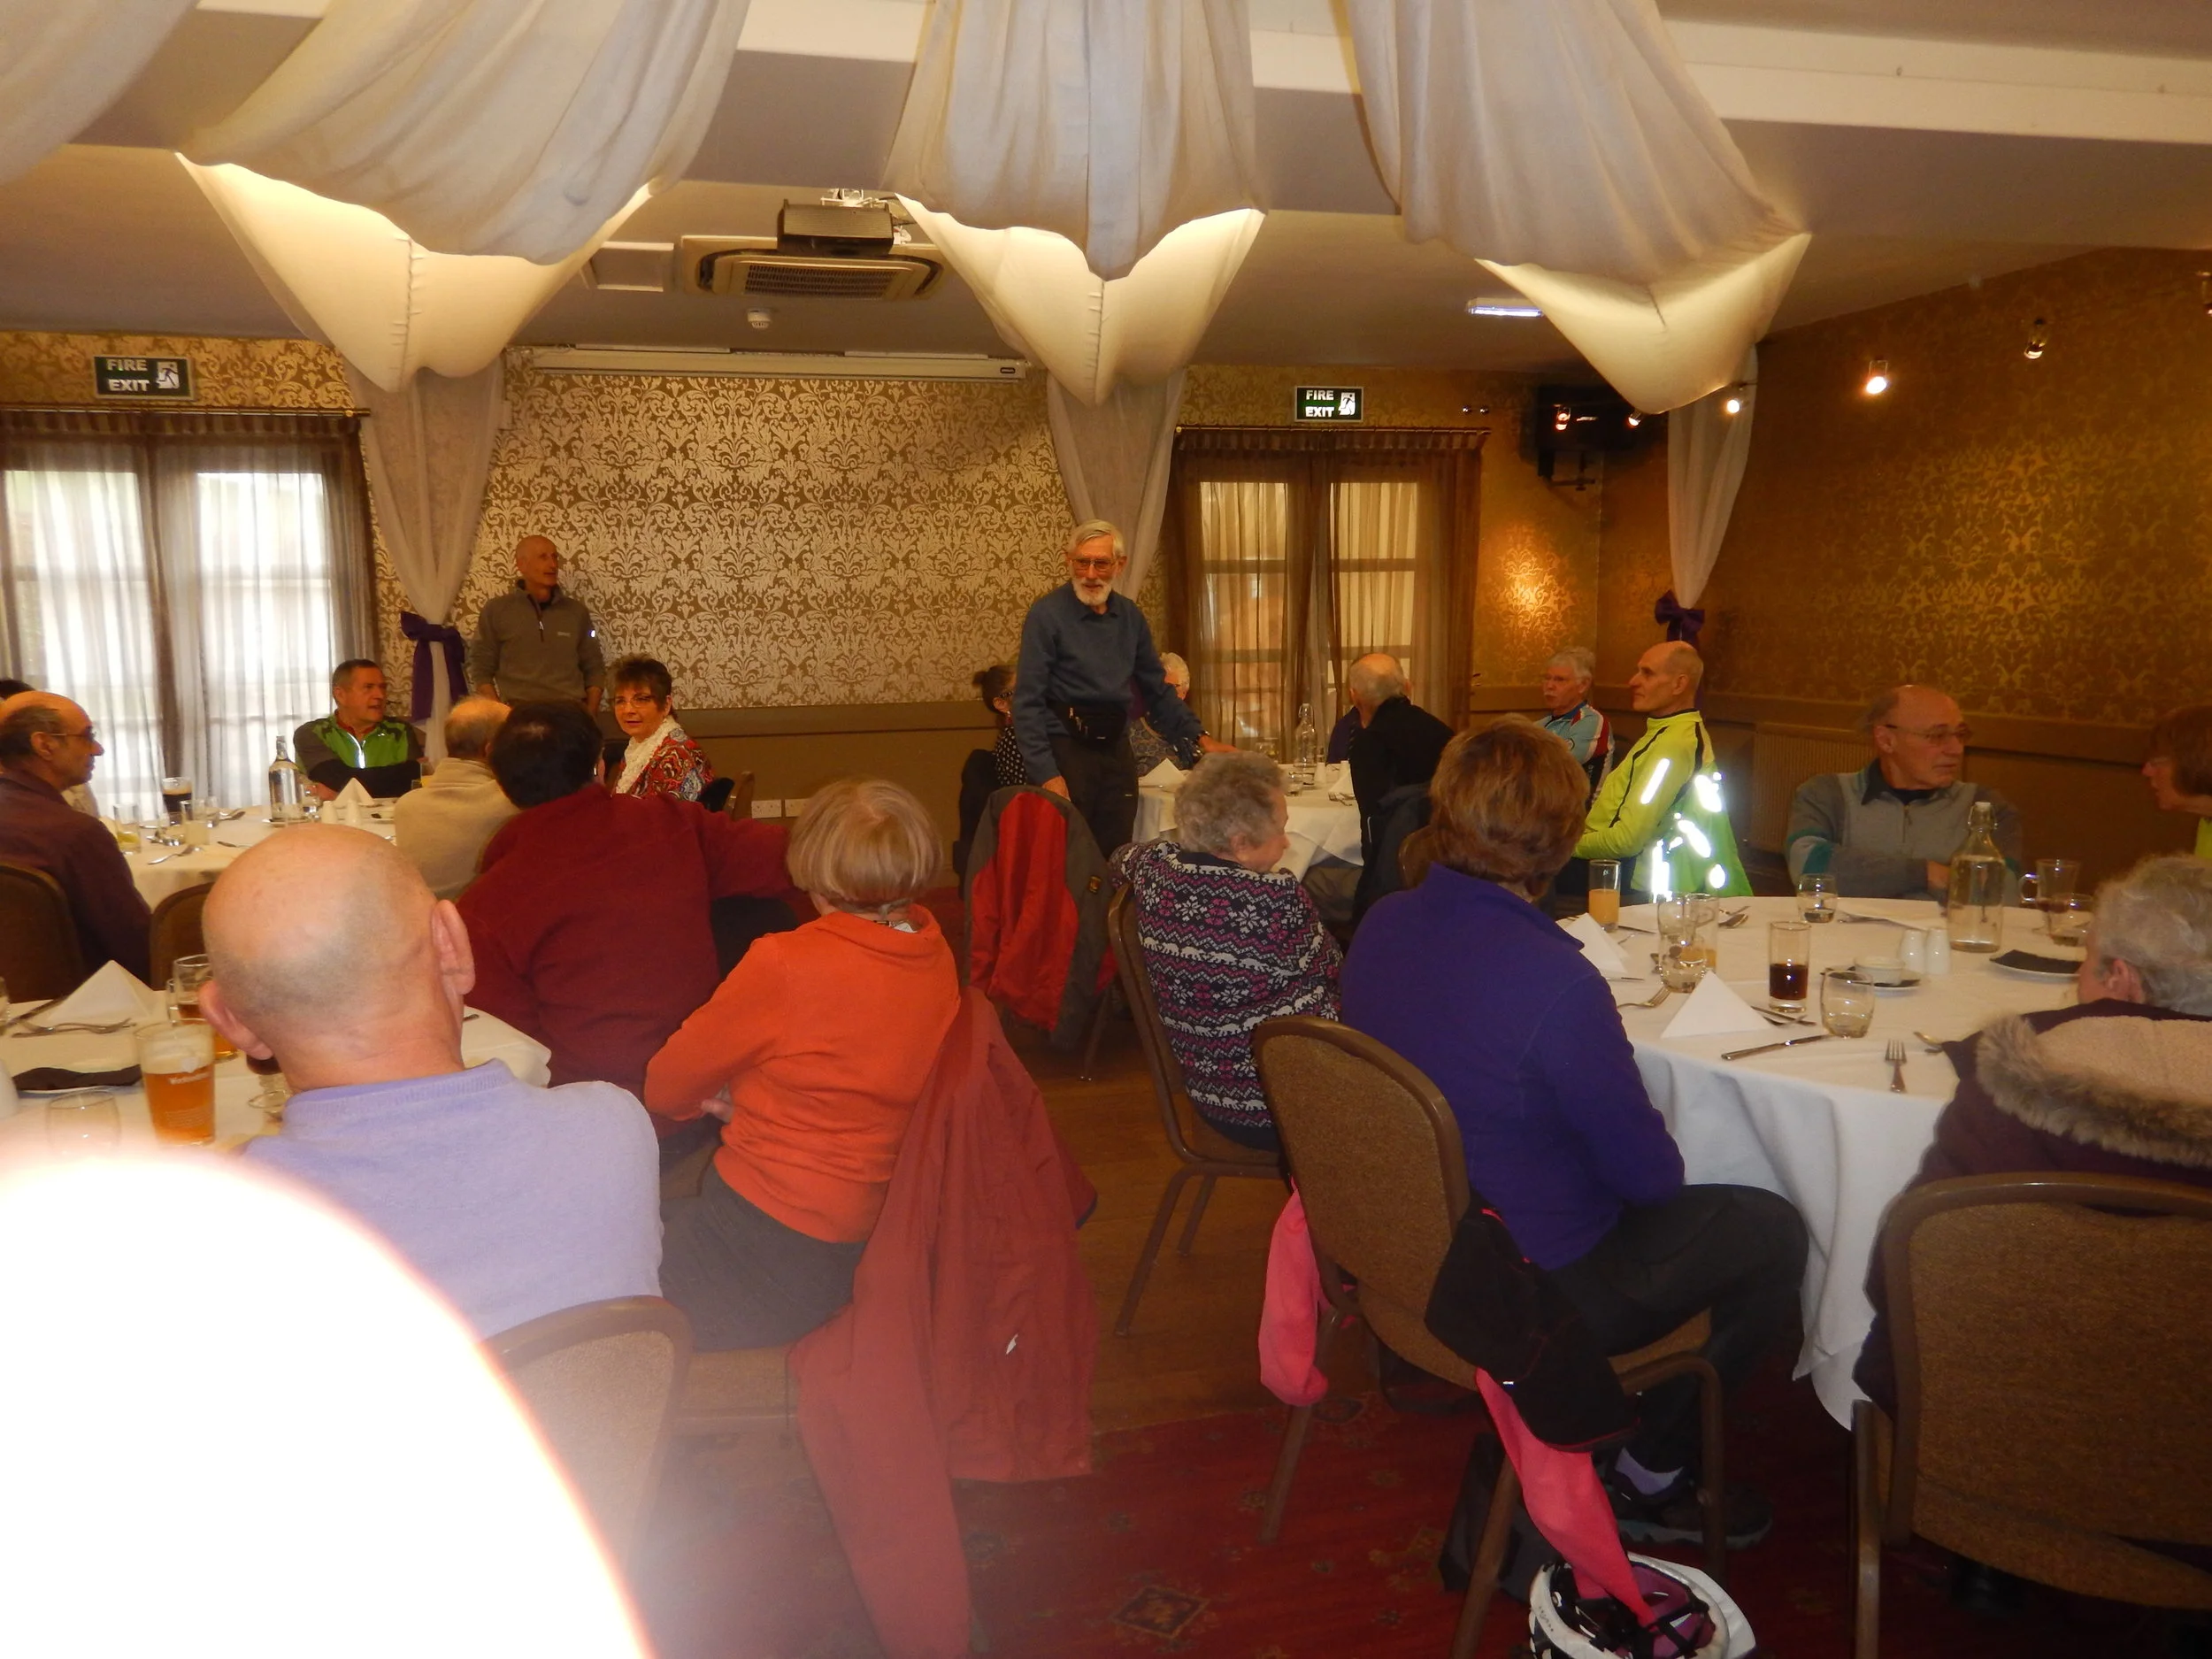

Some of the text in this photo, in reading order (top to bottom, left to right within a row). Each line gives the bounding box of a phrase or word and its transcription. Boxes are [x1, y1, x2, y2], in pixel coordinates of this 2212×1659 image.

[106, 358, 148, 371] FIRE
[108, 379, 150, 392] EXIT
[1306, 389, 1334, 401] FIRE
[1305, 406, 1335, 418] EXIT
